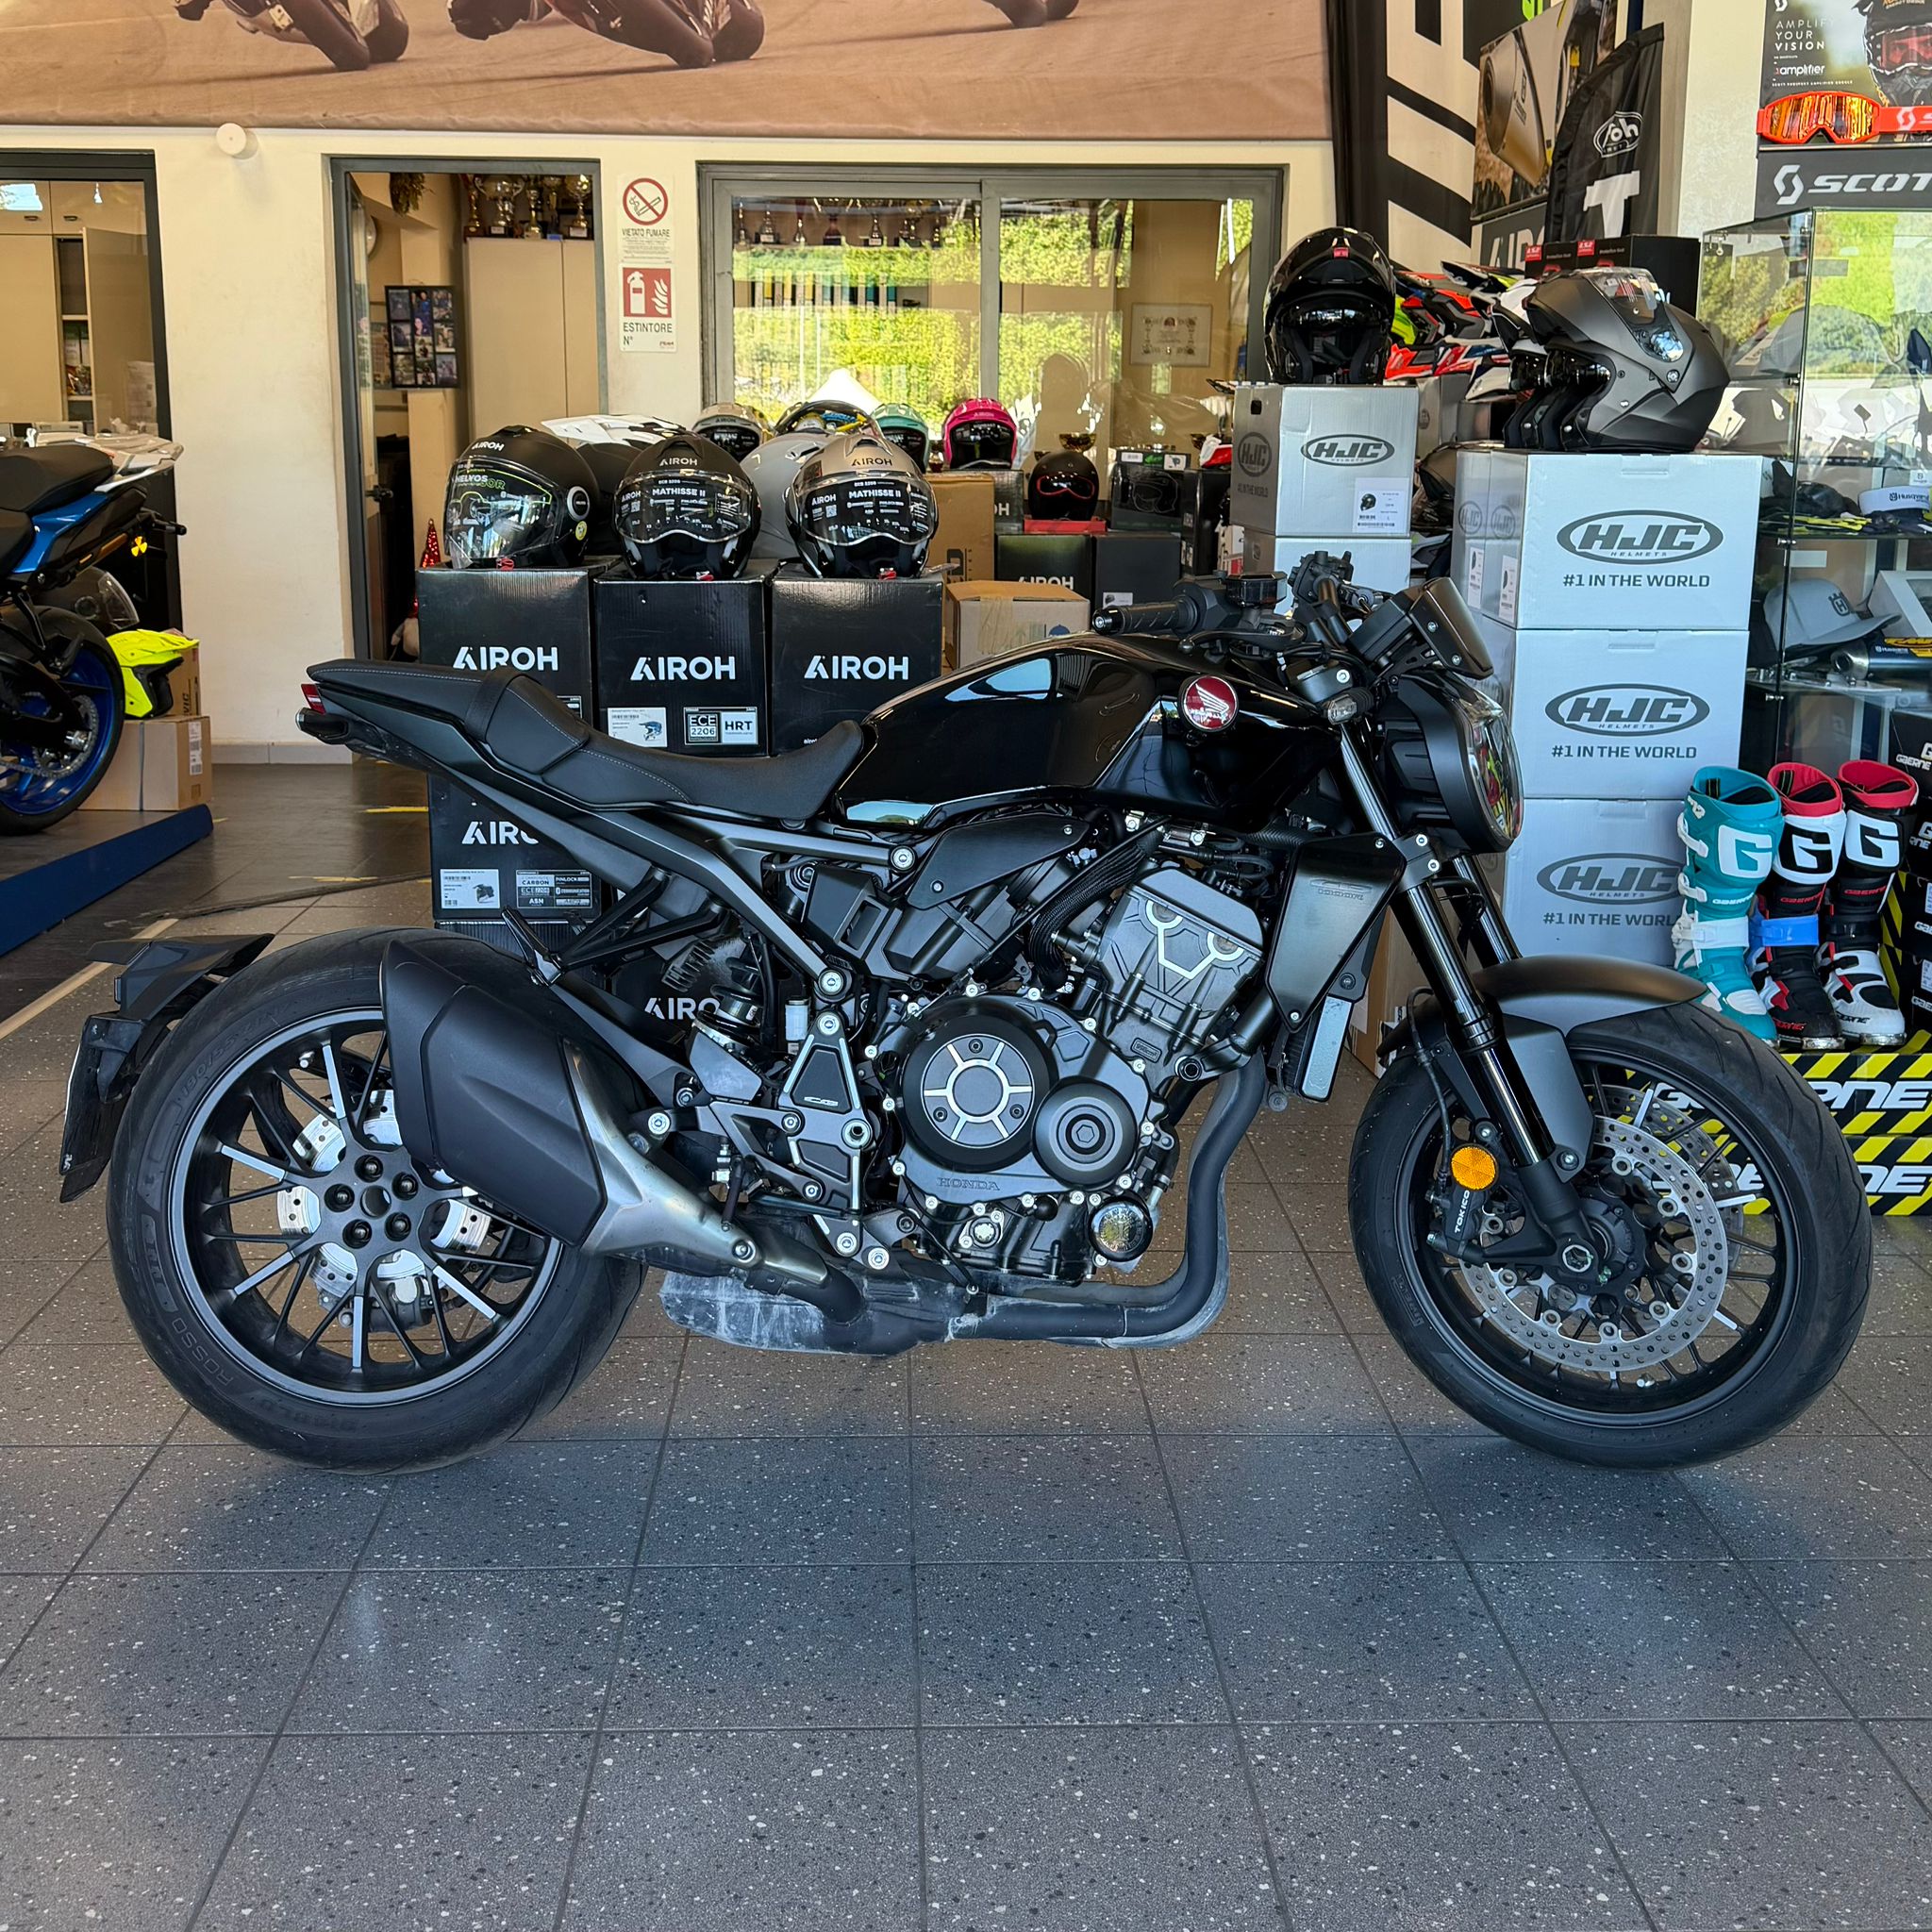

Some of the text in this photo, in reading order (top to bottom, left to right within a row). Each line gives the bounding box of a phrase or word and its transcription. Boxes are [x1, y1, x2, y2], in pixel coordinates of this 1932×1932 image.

[1776, 31, 1813, 40] YOUR
[1775, 42, 1825, 51] VISION
[1780, 64, 1825, 76] amplifier
[622, 228, 670, 237] VIETATO FUMARE
[623, 322, 673, 333] ESTINTORE
[472, 441, 505, 452] AIROH
[1313, 442, 1384, 458] HJC
[1241, 443, 1267, 466] HJC
[659, 458, 698, 467] AIROH
[851, 458, 893, 466] AIROH
[652, 488, 698, 497] MATHISSE
[849, 489, 894, 499] MATHISSE
[812, 494, 836, 506] AIROH
[1578, 524, 1704, 551] HJC
[1562, 575, 1710, 588] #1 IN THE WORLD
[453, 646, 558, 672] AIROH
[631, 657, 736, 681] AIROH
[805, 656, 909, 680] AIROH
[1566, 697, 1691, 724] HJC
[691, 716, 716, 727] ECE
[724, 721, 753, 731] HRT
[691, 728, 716, 736] 2206
[1551, 745, 1697, 759] #1 IN THE WORLD
[462, 821, 539, 845] AIR
[1845, 810, 1900, 867] G
[1718, 824, 1773, 879] G
[1778, 825, 1833, 874] G
[1557, 866, 1683, 893] HJC
[1543, 913, 1680, 926] #1 IN THE WORL
[936, 1178, 1000, 1191] HONDA
[1454, 1190, 1470, 1233] TOKICO
[171, 1317, 234, 1386] ROSSO
